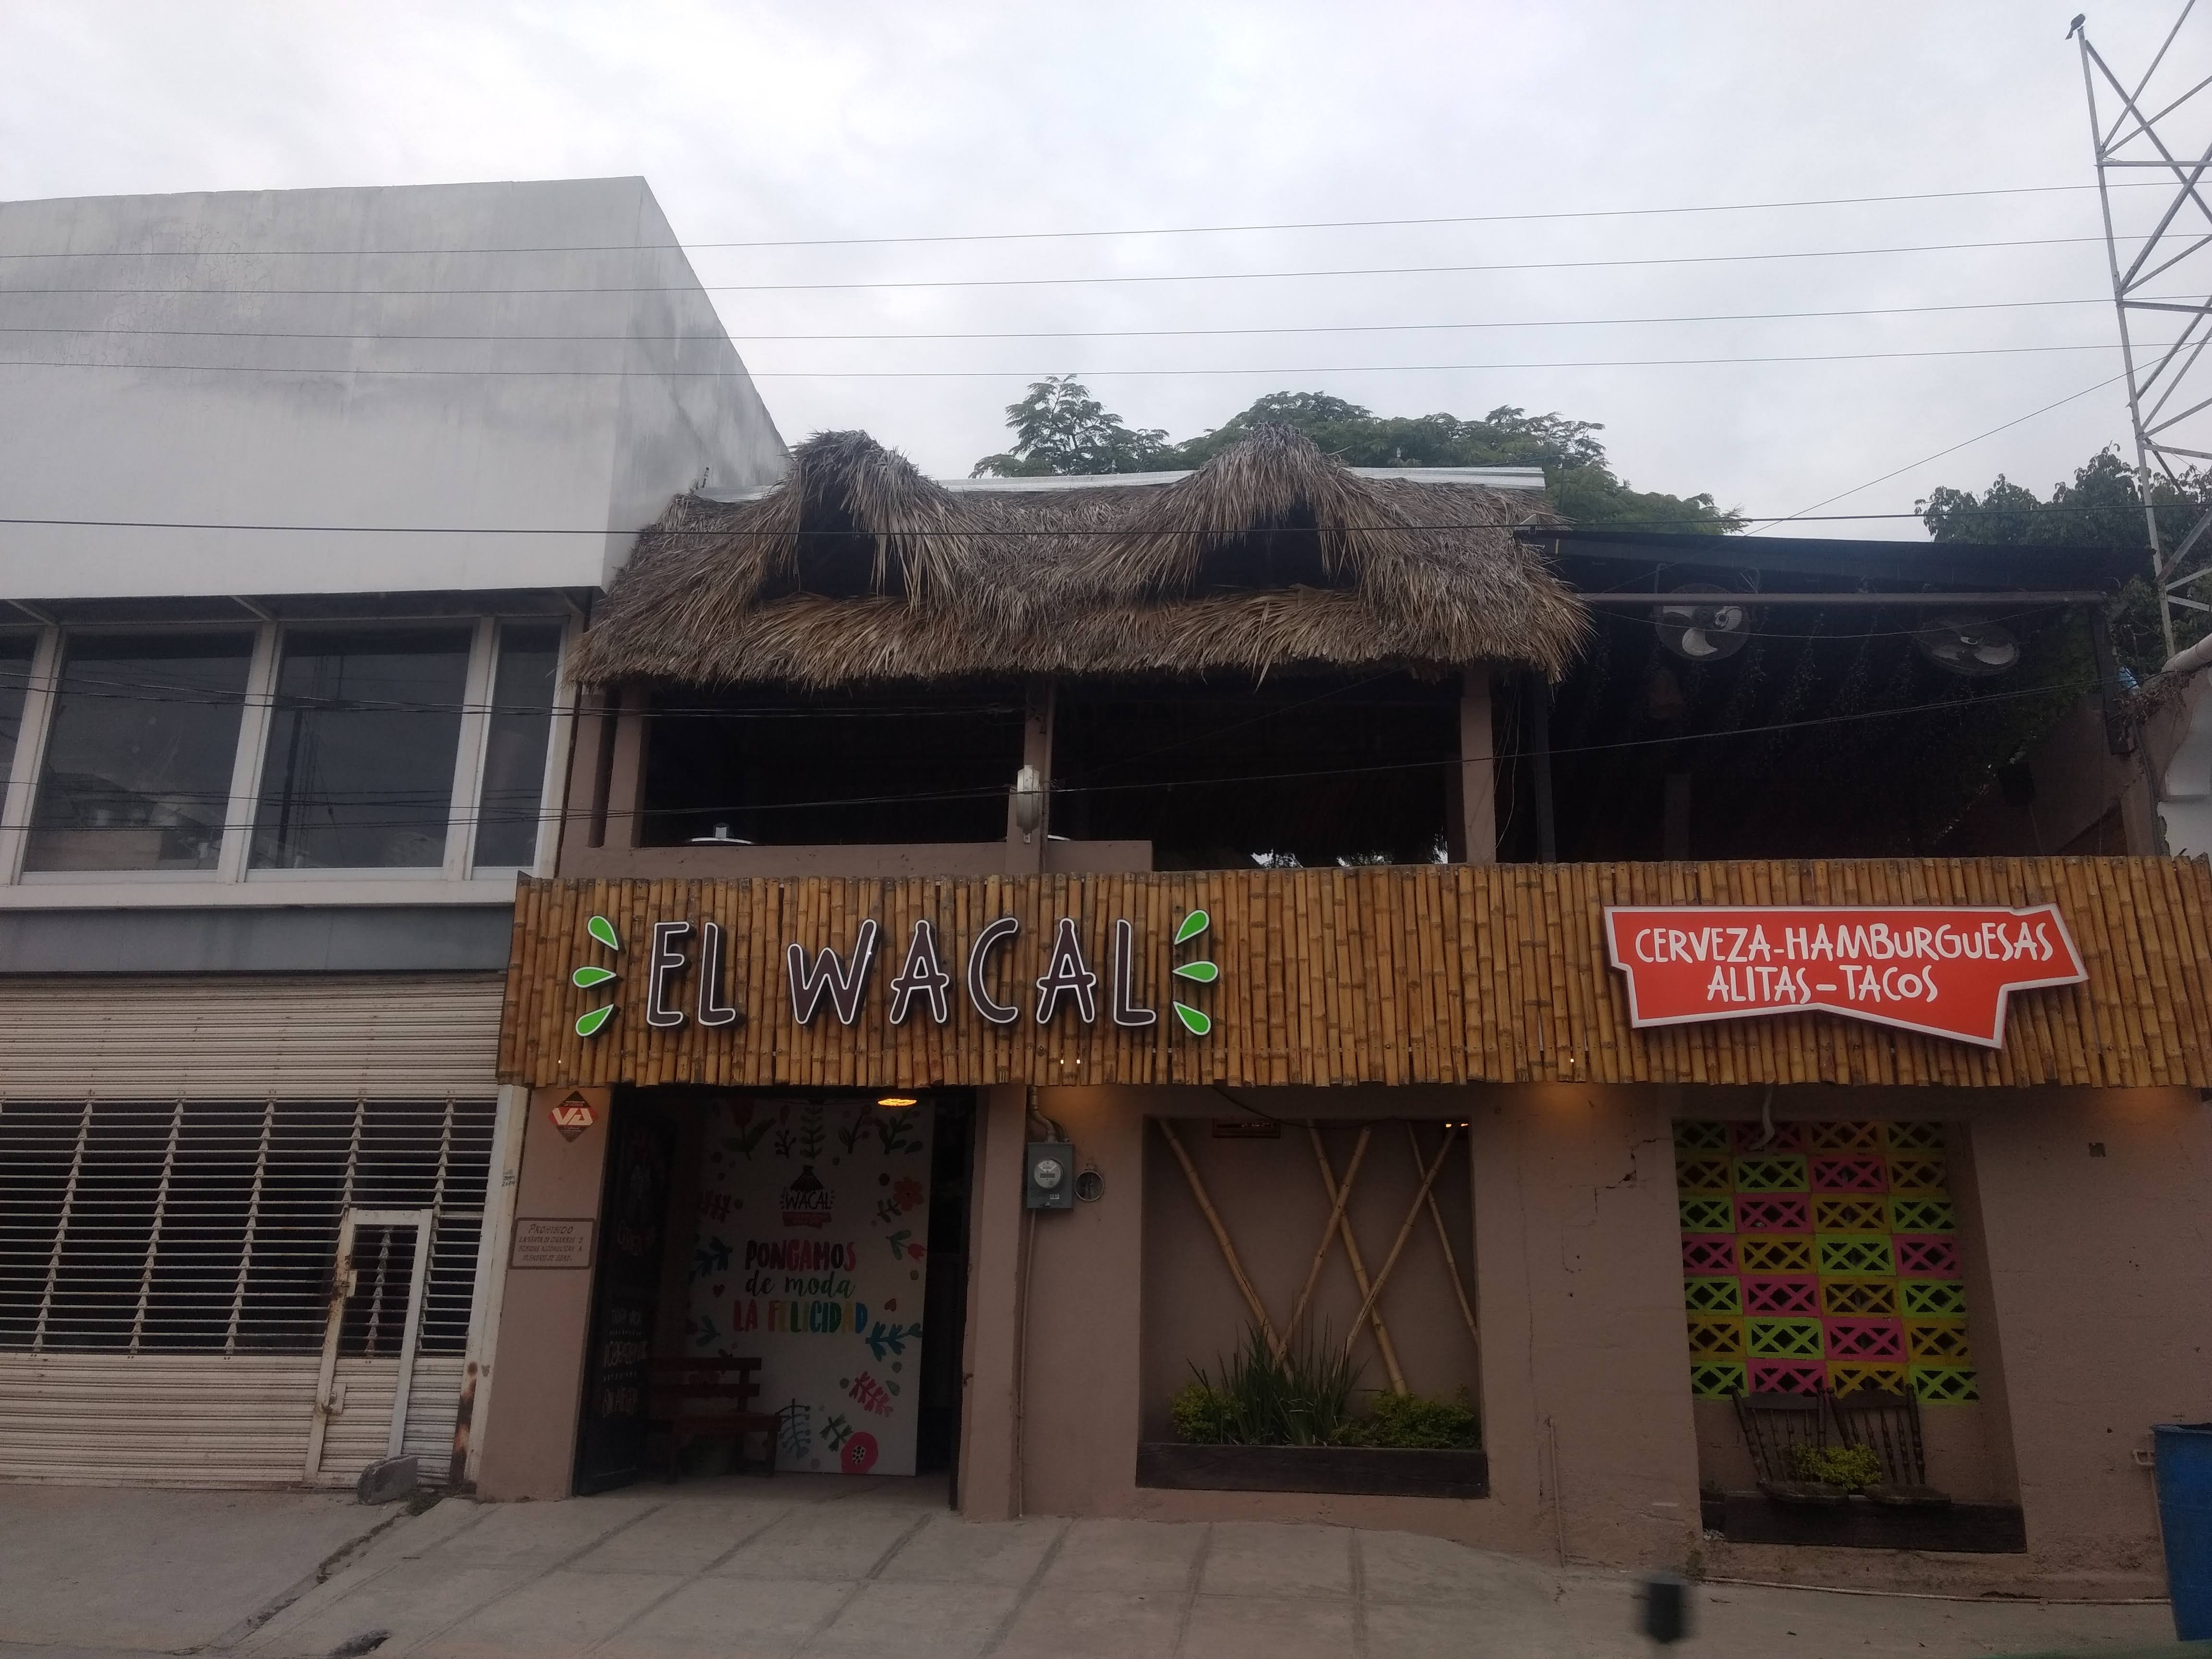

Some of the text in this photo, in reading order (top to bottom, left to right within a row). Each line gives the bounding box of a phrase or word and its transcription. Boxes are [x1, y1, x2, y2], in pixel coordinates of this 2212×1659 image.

[646, 916, 1156, 1028] EL WACAL
[528, 1224, 574, 1234] PROHIBIDO
[745, 1239, 856, 1271] PONGAMOS
[745, 1270, 856, 1299] de moda
[733, 1299, 868, 1334] LA FELICIDAD
